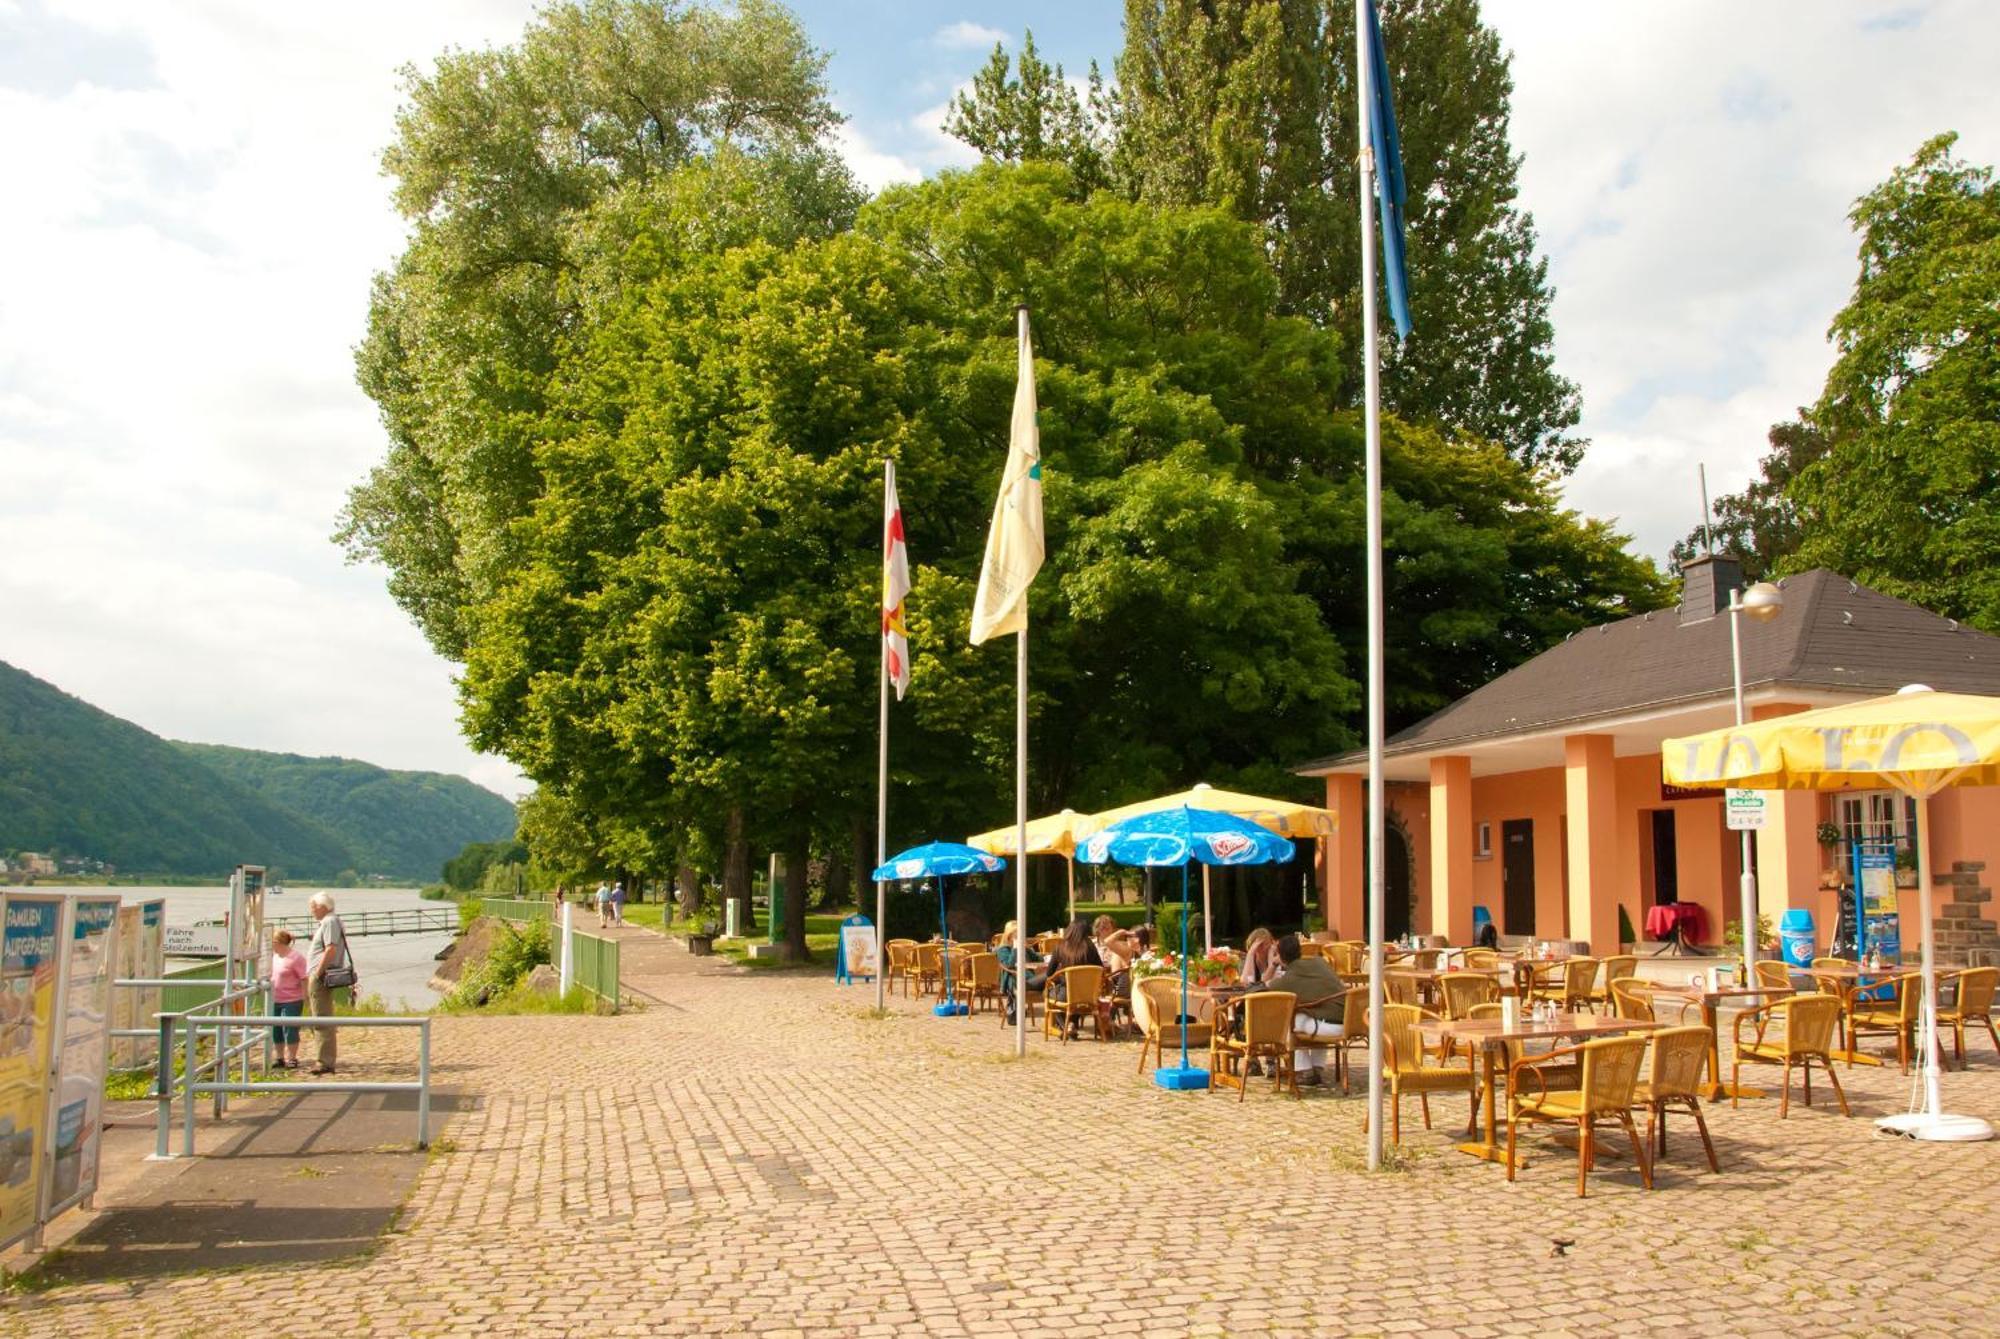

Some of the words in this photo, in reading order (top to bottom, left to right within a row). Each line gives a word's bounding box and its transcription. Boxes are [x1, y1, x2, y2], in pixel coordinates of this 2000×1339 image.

[7, 907, 42, 928] FAMILIEN
[167, 928, 194, 936] Fähre
[169, 936, 192, 944] nach
